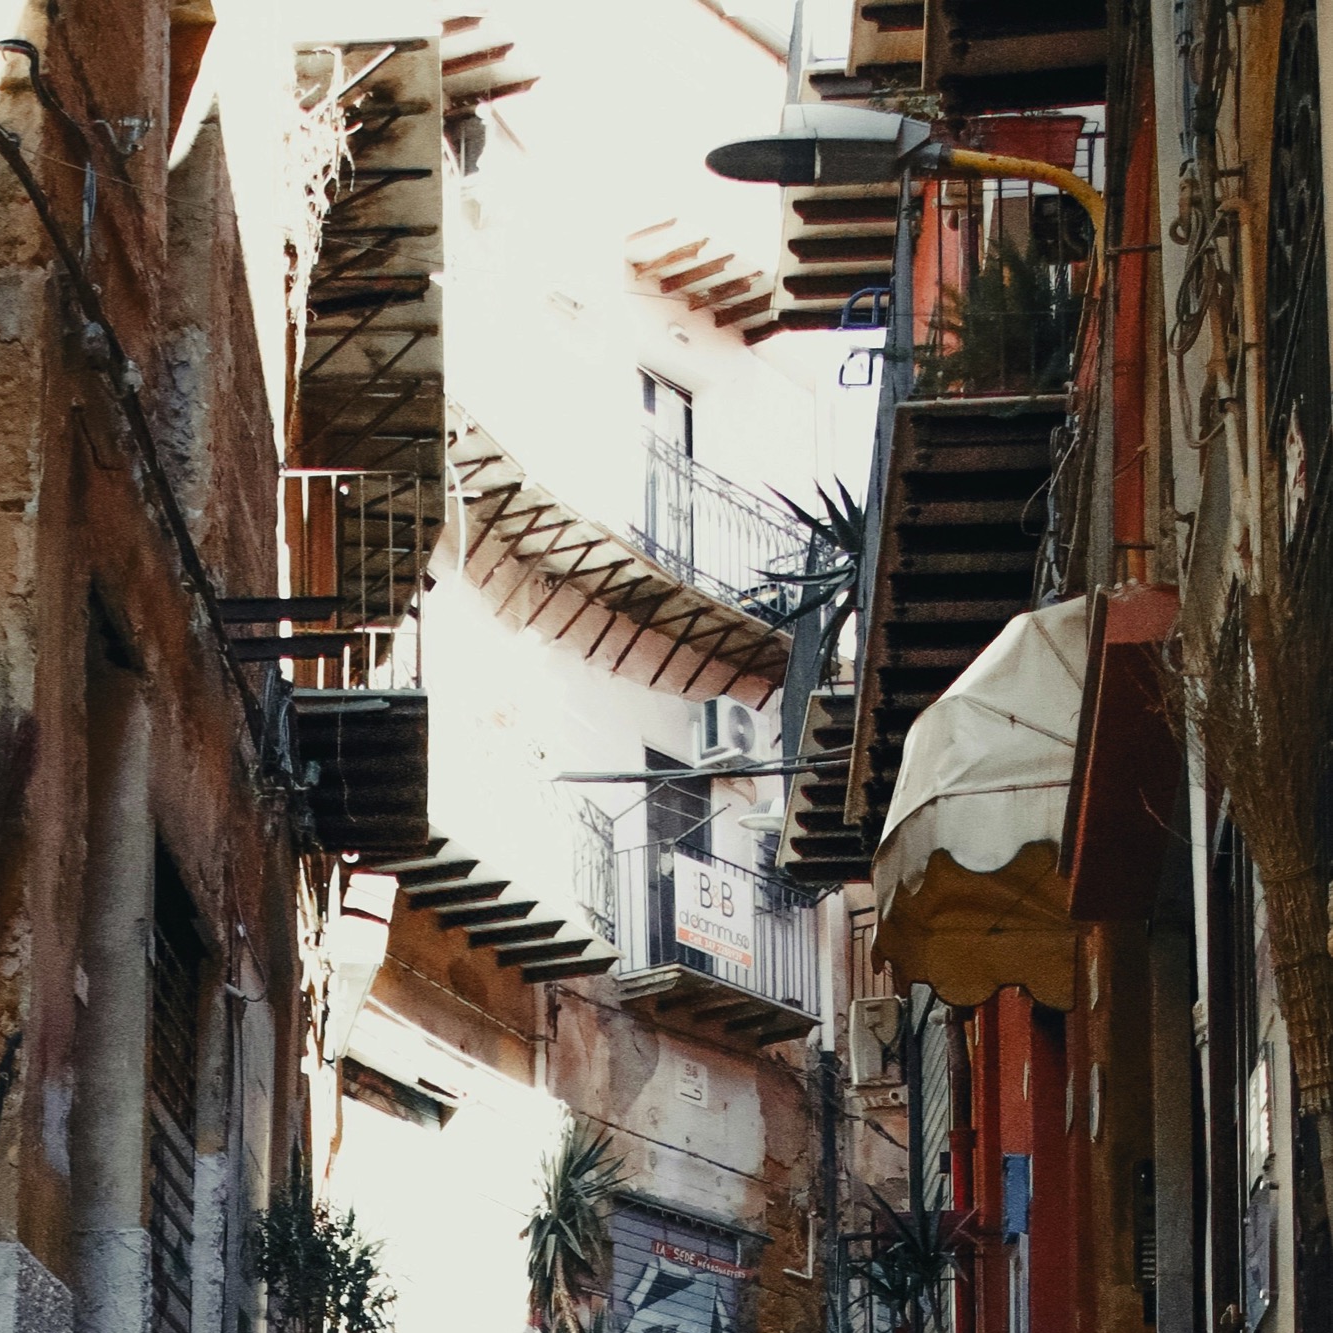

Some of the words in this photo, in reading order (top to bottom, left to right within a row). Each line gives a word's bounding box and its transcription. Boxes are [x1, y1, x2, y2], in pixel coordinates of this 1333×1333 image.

[700, 872, 734, 917] B&B
[655, 1242, 665, 1256] LA
[673, 1248, 696, 1265] SEDE
